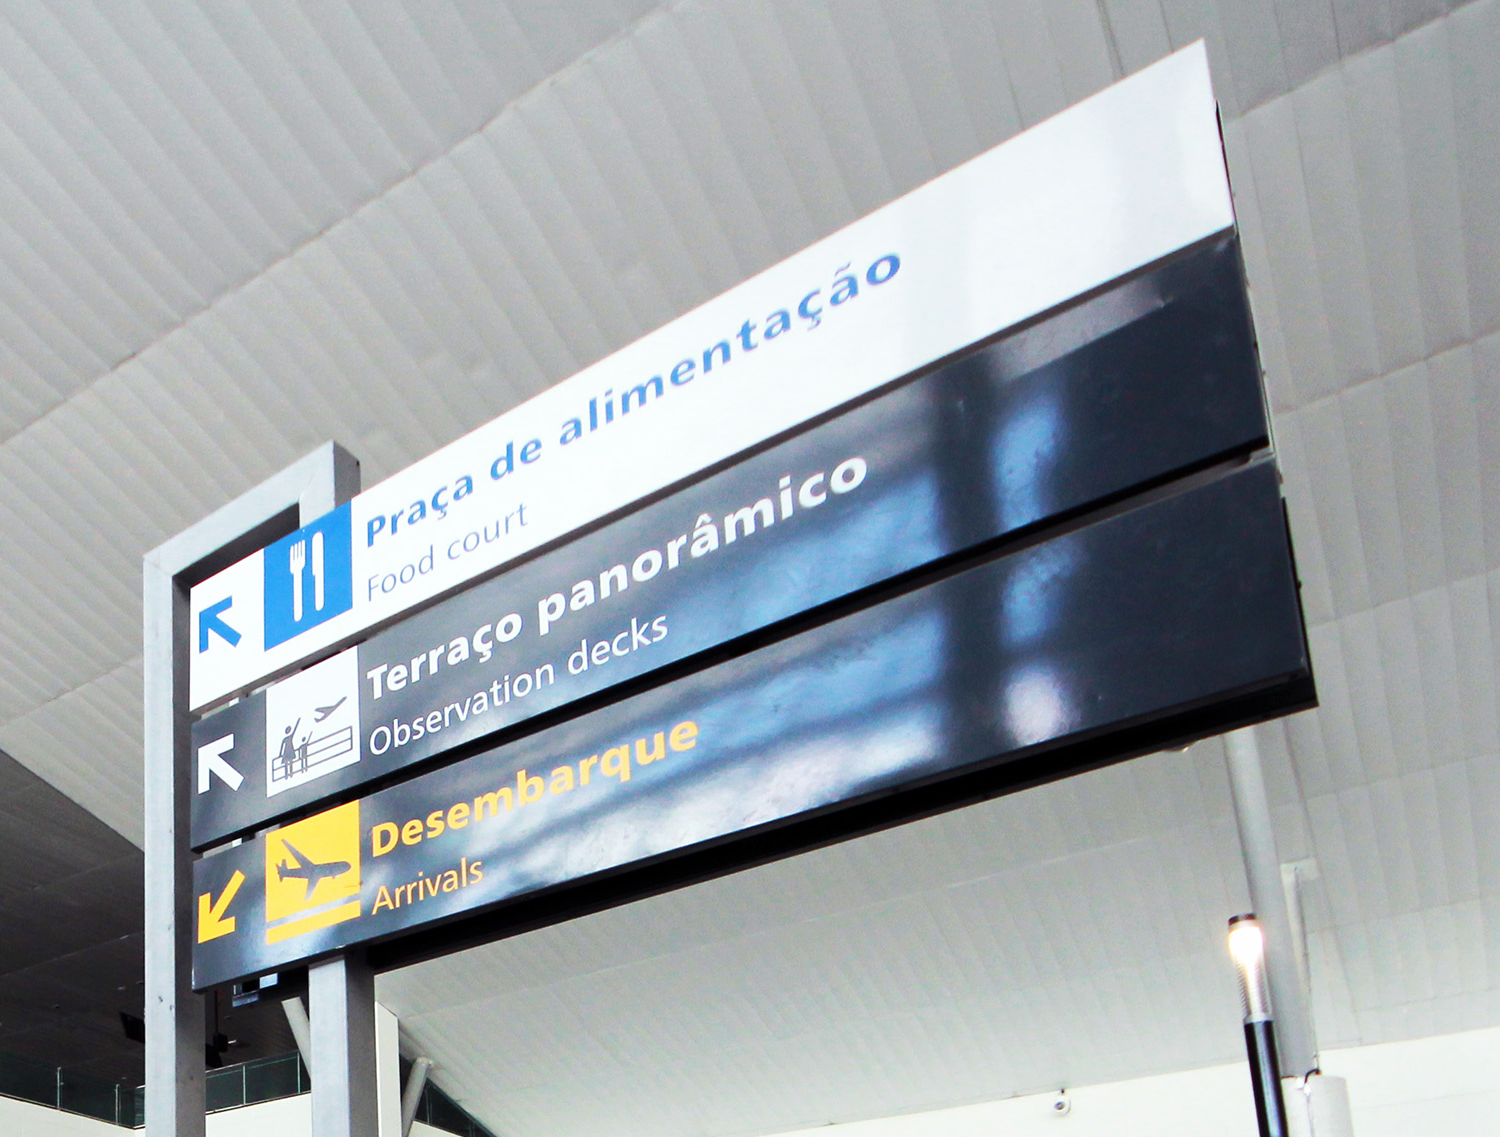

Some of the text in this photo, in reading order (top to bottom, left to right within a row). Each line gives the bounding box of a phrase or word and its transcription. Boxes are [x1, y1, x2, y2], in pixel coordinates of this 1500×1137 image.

[366, 252, 901, 548] Praça de alimentação
[367, 456, 869, 701] Terraço panorâmico
[368, 502, 529, 602] Food court
[370, 611, 670, 757] Observation decks
[372, 720, 700, 858] Desembarque
[372, 857, 484, 915] Arrivals
